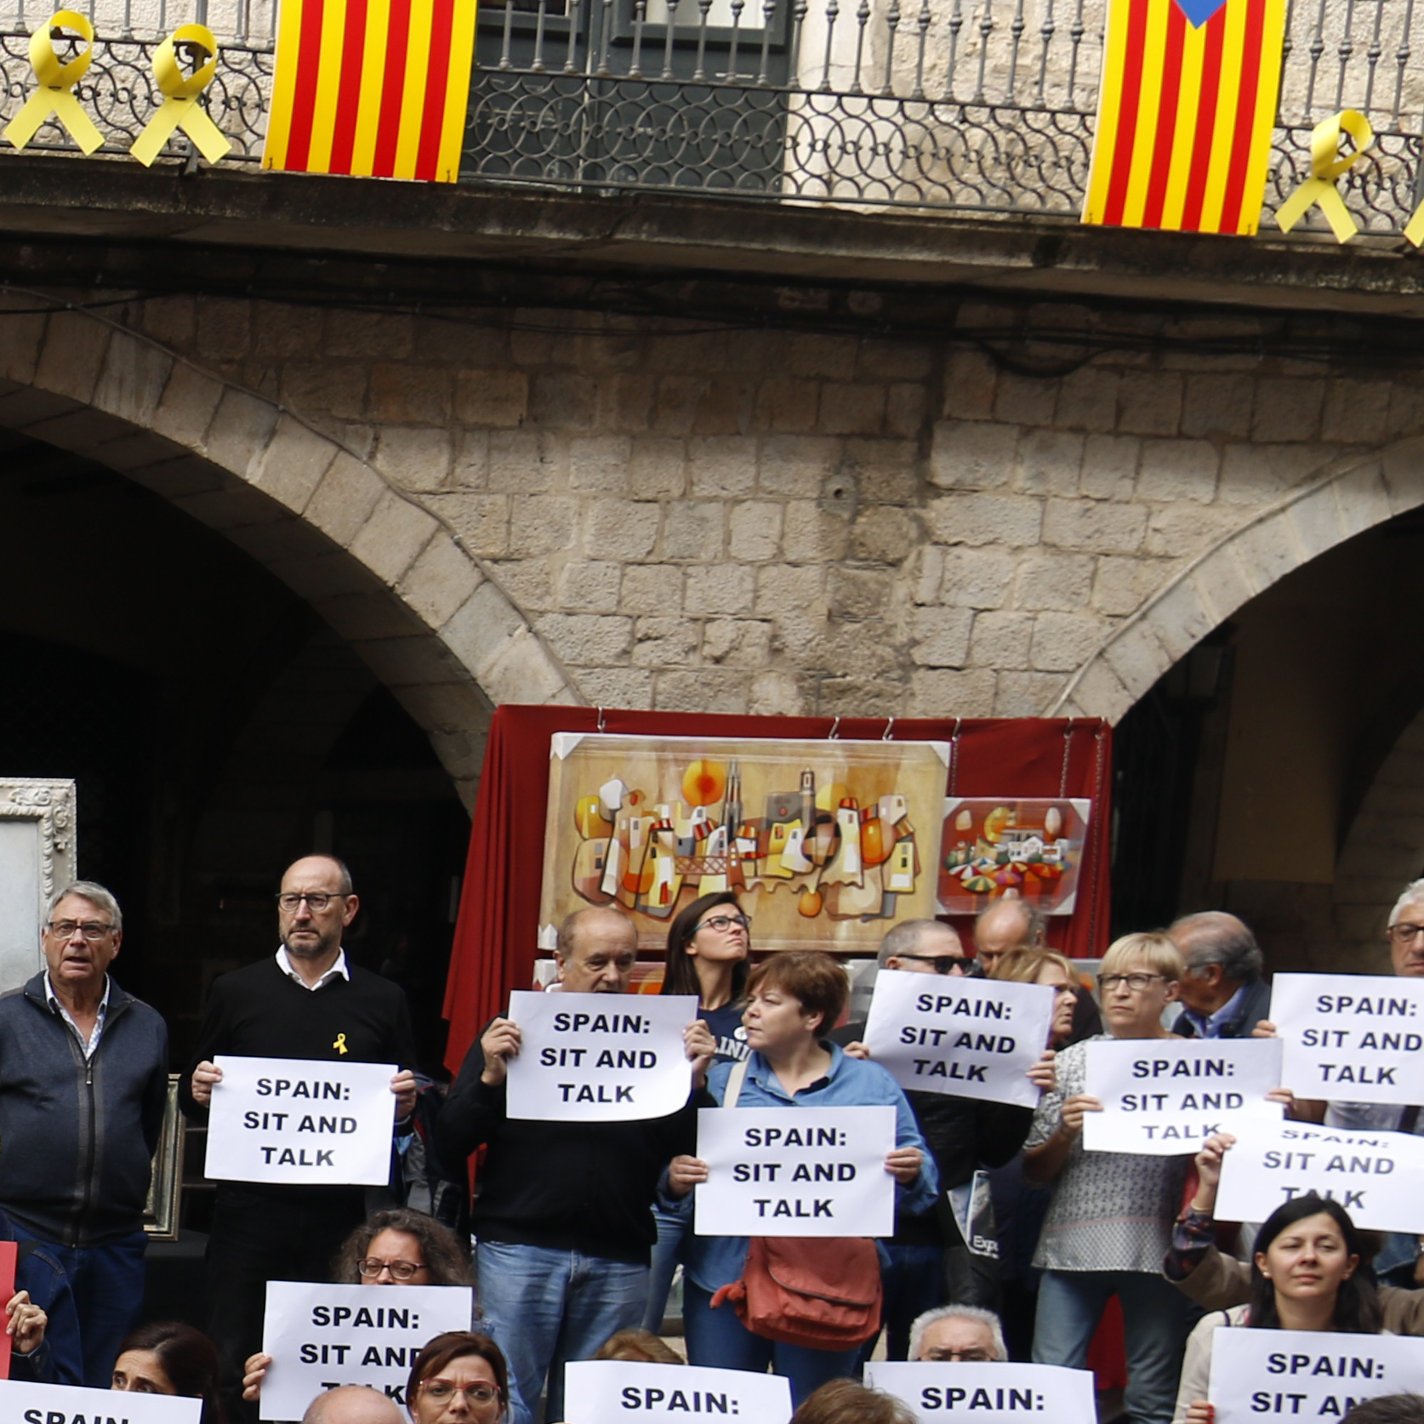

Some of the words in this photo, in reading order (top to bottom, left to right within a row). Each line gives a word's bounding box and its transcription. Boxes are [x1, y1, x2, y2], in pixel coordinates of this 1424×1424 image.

[917, 994, 1011, 1020] SPAIN:
[1317, 995, 1416, 1016] SPAIN:
[554, 1013, 650, 1033] SPAIN:
[900, 1027, 947, 1047] SIT
[954, 1032, 1016, 1055] AND
[1302, 1029, 1349, 1047] SIT
[1359, 1032, 1422, 1051] AND
[541, 1048, 587, 1067] SIT
[596, 1050, 656, 1068] AND
[1133, 1059, 1233, 1078] SPAIN:
[913, 1059, 988, 1082] TALK
[1319, 1064, 1395, 1085] TALK
[257, 1079, 349, 1100] SPAIN:
[558, 1084, 633, 1102] TALK
[1121, 1094, 1168, 1111] SIT
[1181, 1093, 1243, 1110] AND
[244, 1112, 288, 1130] SIT
[298, 1115, 356, 1133] AND
[1142, 1124, 1220, 1139] TALK
[745, 1128, 845, 1146] SPAIN:
[261, 1147, 333, 1166] TALK
[1263, 1151, 1315, 1170] SIT
[1325, 1156, 1394, 1174] AND
[734, 1164, 781, 1182] SIT
[792, 1164, 856, 1181] AND
[754, 1200, 833, 1217] TALK
[312, 1306, 418, 1329] SPAIN:
[300, 1344, 350, 1364] SIT
[1268, 1354, 1384, 1379] SPAIN:
[622, 1387, 738, 1414] SPAIN:
[922, 1388, 1043, 1410] SPAIN:
[1251, 1392, 1307, 1414] SIT
